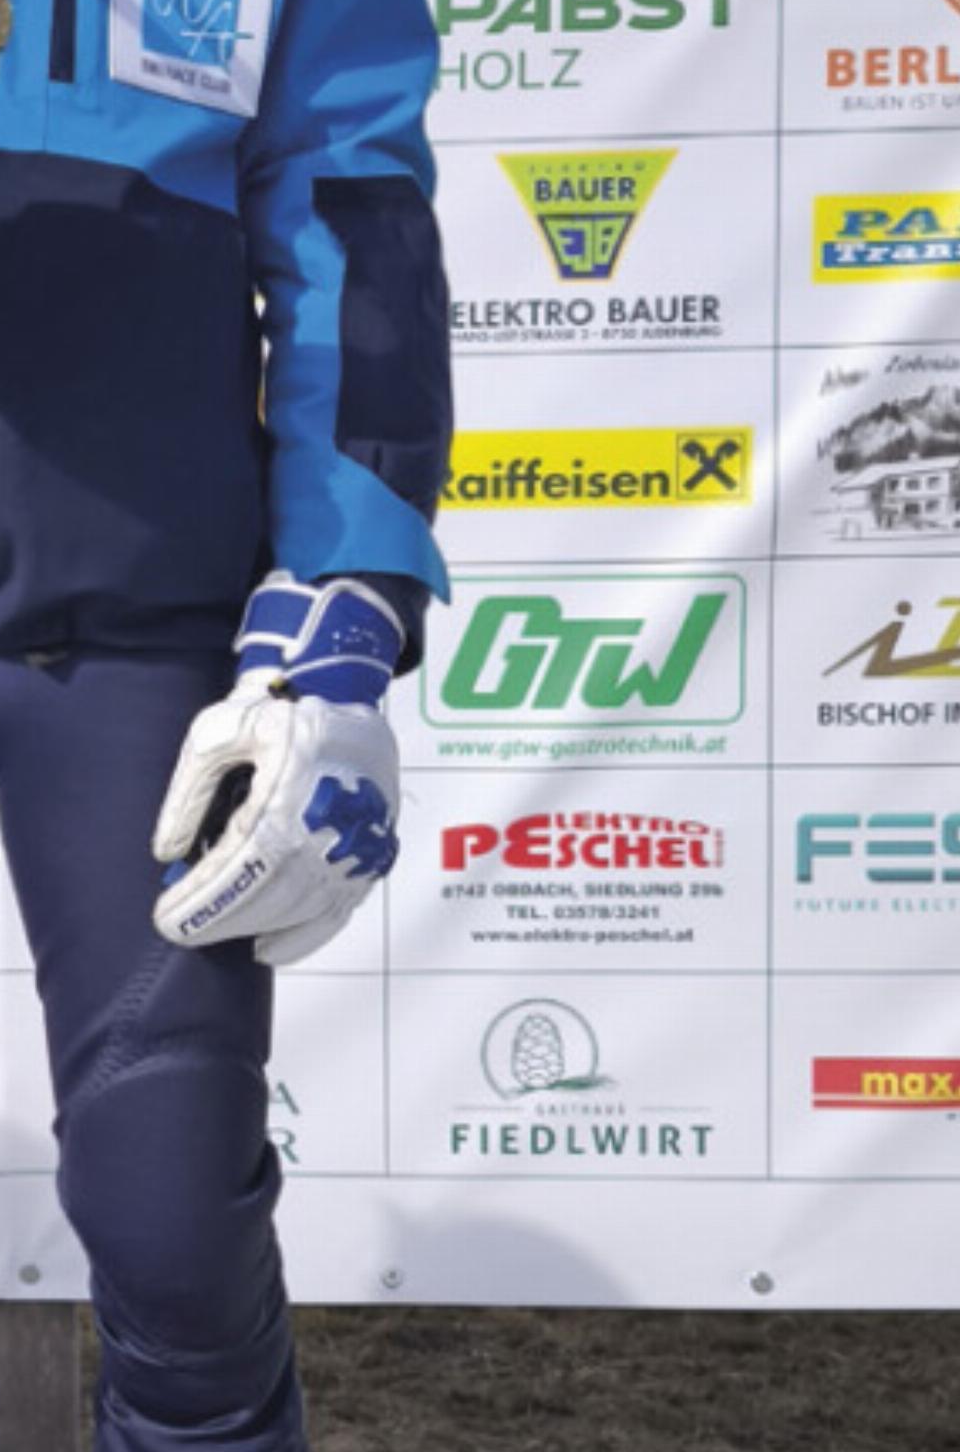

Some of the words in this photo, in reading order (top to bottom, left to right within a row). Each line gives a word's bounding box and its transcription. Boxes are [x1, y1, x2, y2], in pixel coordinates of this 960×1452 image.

[434, 48, 583, 92] HOLZ
[534, 177, 637, 203] BAUER
[451, 299, 595, 329] ELEKTRO
[608, 295, 721, 324] BAUER
[817, 702, 936, 726] BISCHOF
[437, 734, 728, 760] www.gtw-gastrotechnik.at
[179, 855, 268, 938] reusch
[492, 883, 579, 900] OBDACH,
[584, 882, 683, 898] SIEDLUNG
[506, 905, 548, 919] TEL.
[450, 1123, 714, 1156] FIEDLWIRT
